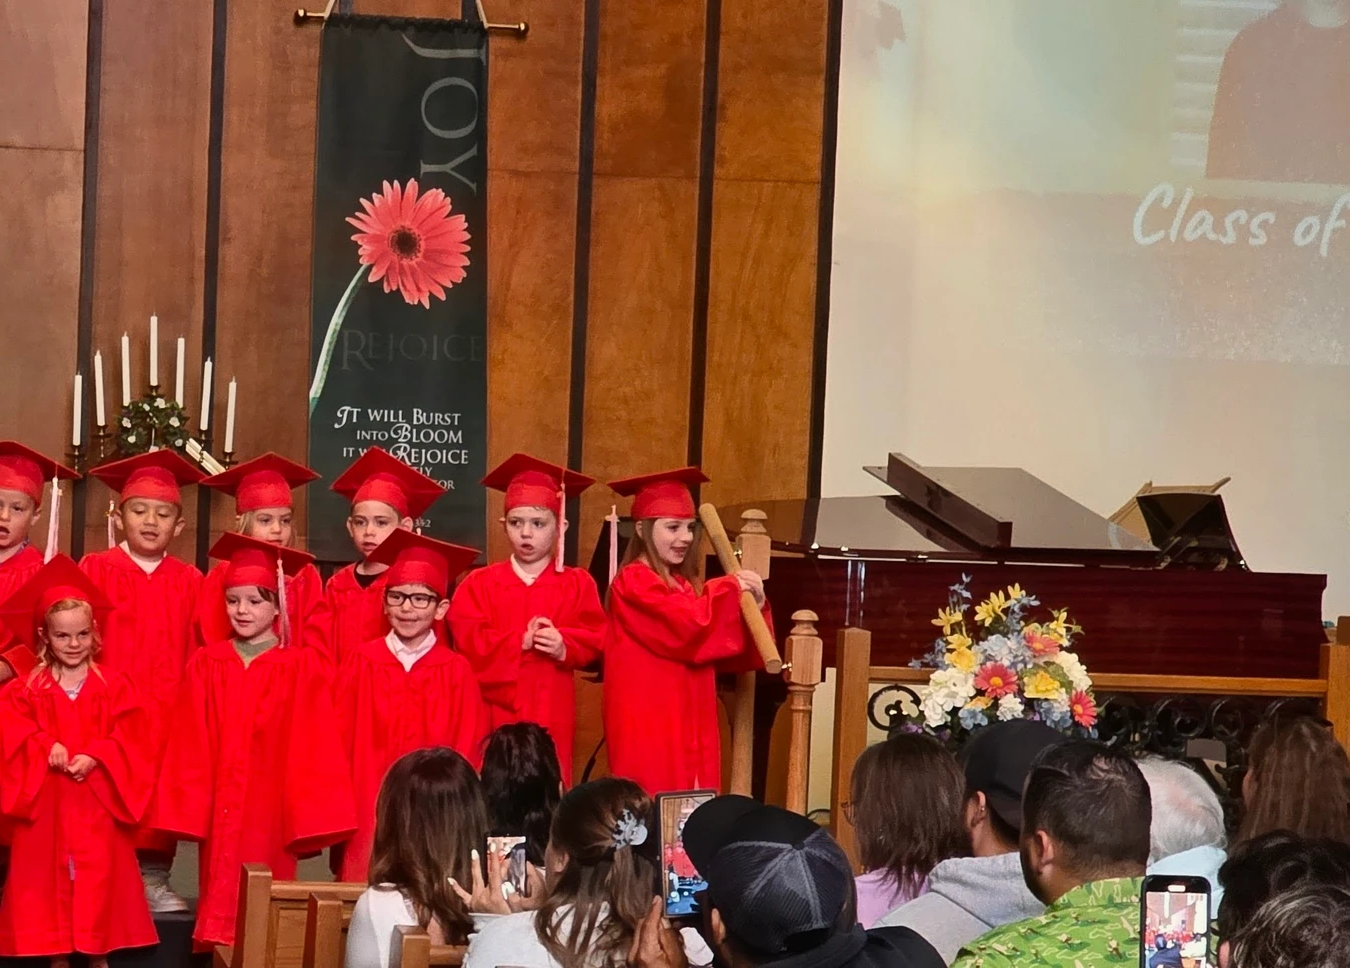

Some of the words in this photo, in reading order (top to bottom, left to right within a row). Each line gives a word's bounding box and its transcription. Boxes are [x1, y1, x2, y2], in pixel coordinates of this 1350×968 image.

[402, 32, 486, 196] JOY
[1133, 182, 1277, 246] Class
[1292, 192, 1350, 258] of
[367, 409, 406, 423] WILL
[356, 430, 389, 441] INTO
[343, 447, 355, 458] IT
